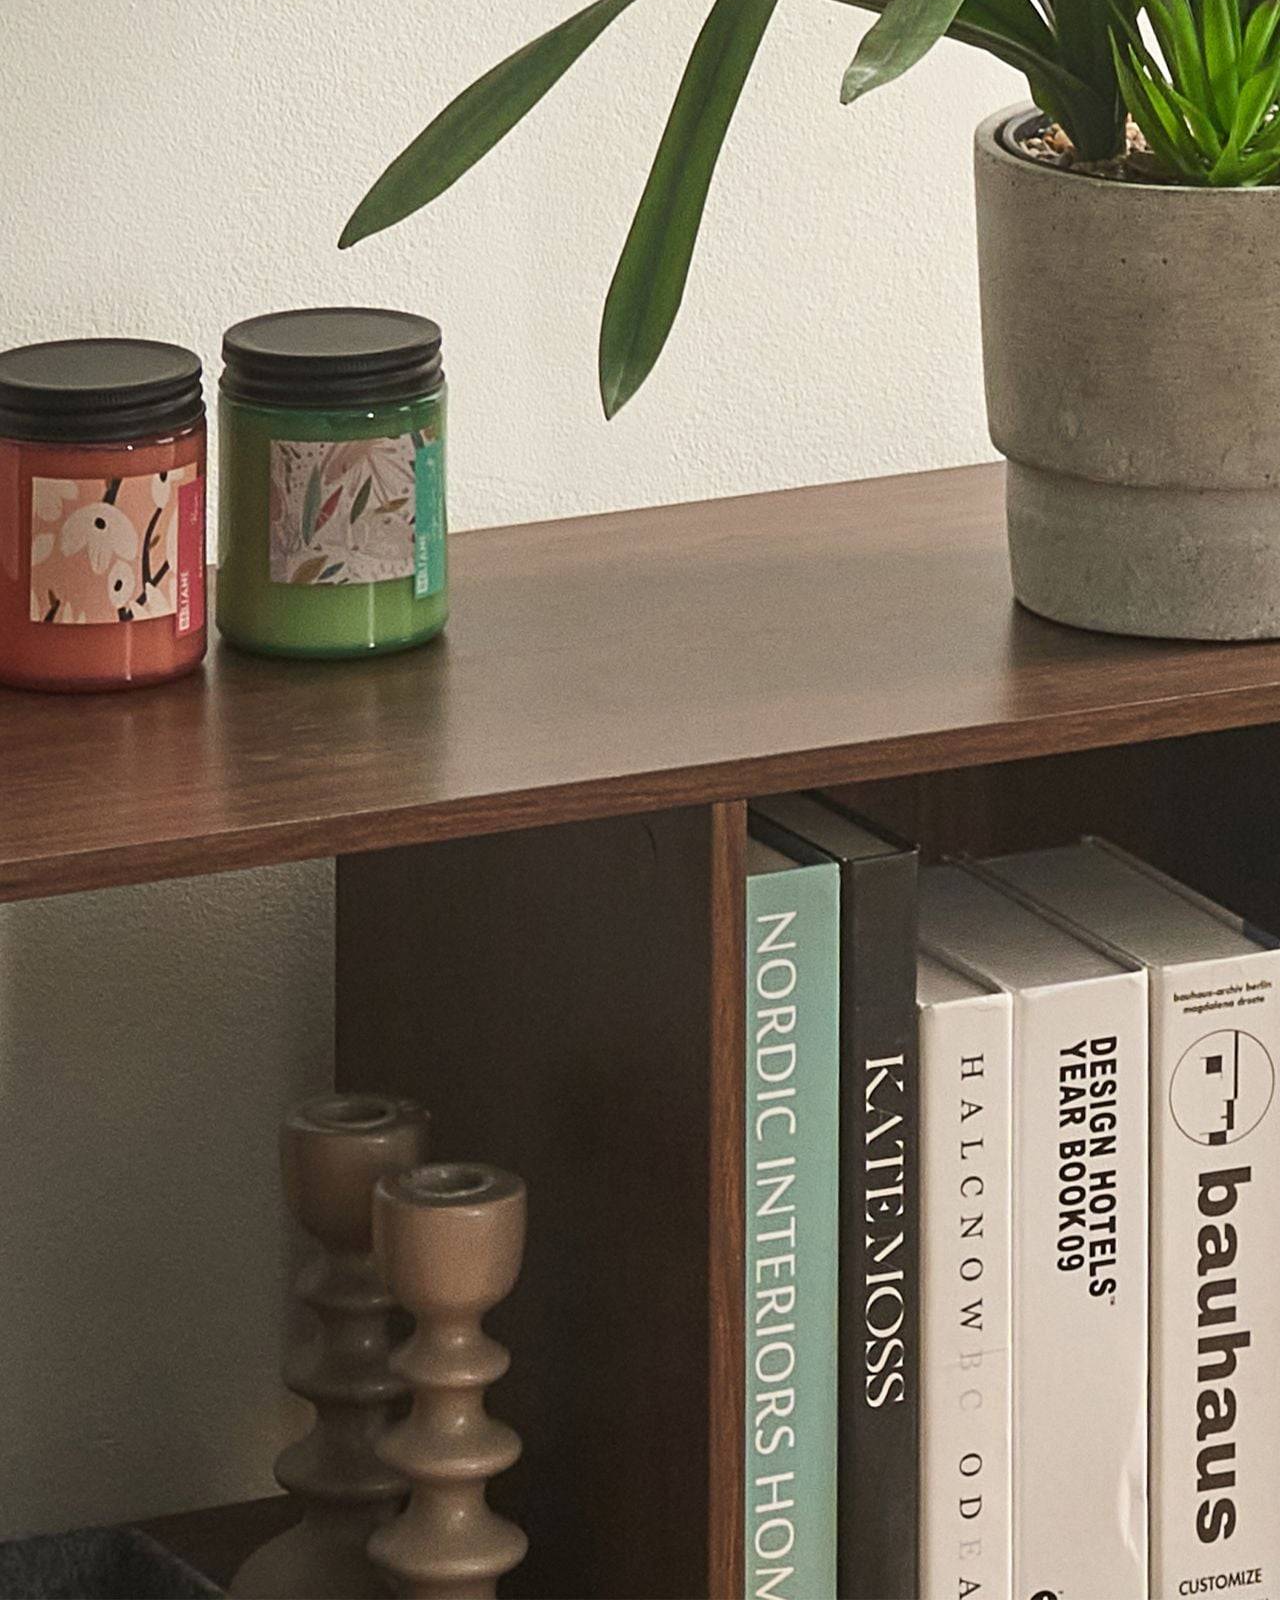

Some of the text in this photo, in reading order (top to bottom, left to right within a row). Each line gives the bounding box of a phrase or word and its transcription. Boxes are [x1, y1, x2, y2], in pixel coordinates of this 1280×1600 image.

[756, 911, 797, 1142] NORDIC
[1173, 980, 1272, 1002] bauhaus-archiv berlin
[1183, 995, 1265, 1014] magdalena droste
[1059, 1040, 1087, 1128] YEAR
[1090, 1036, 1117, 1157] DESIGN
[866, 1054, 905, 1409] KATE MOSS
[755, 1156, 796, 1456] INTERIORS
[1196, 1166, 1252, 1544] bauhaus
[1179, 1568, 1263, 1596] CUSTOMIZE
